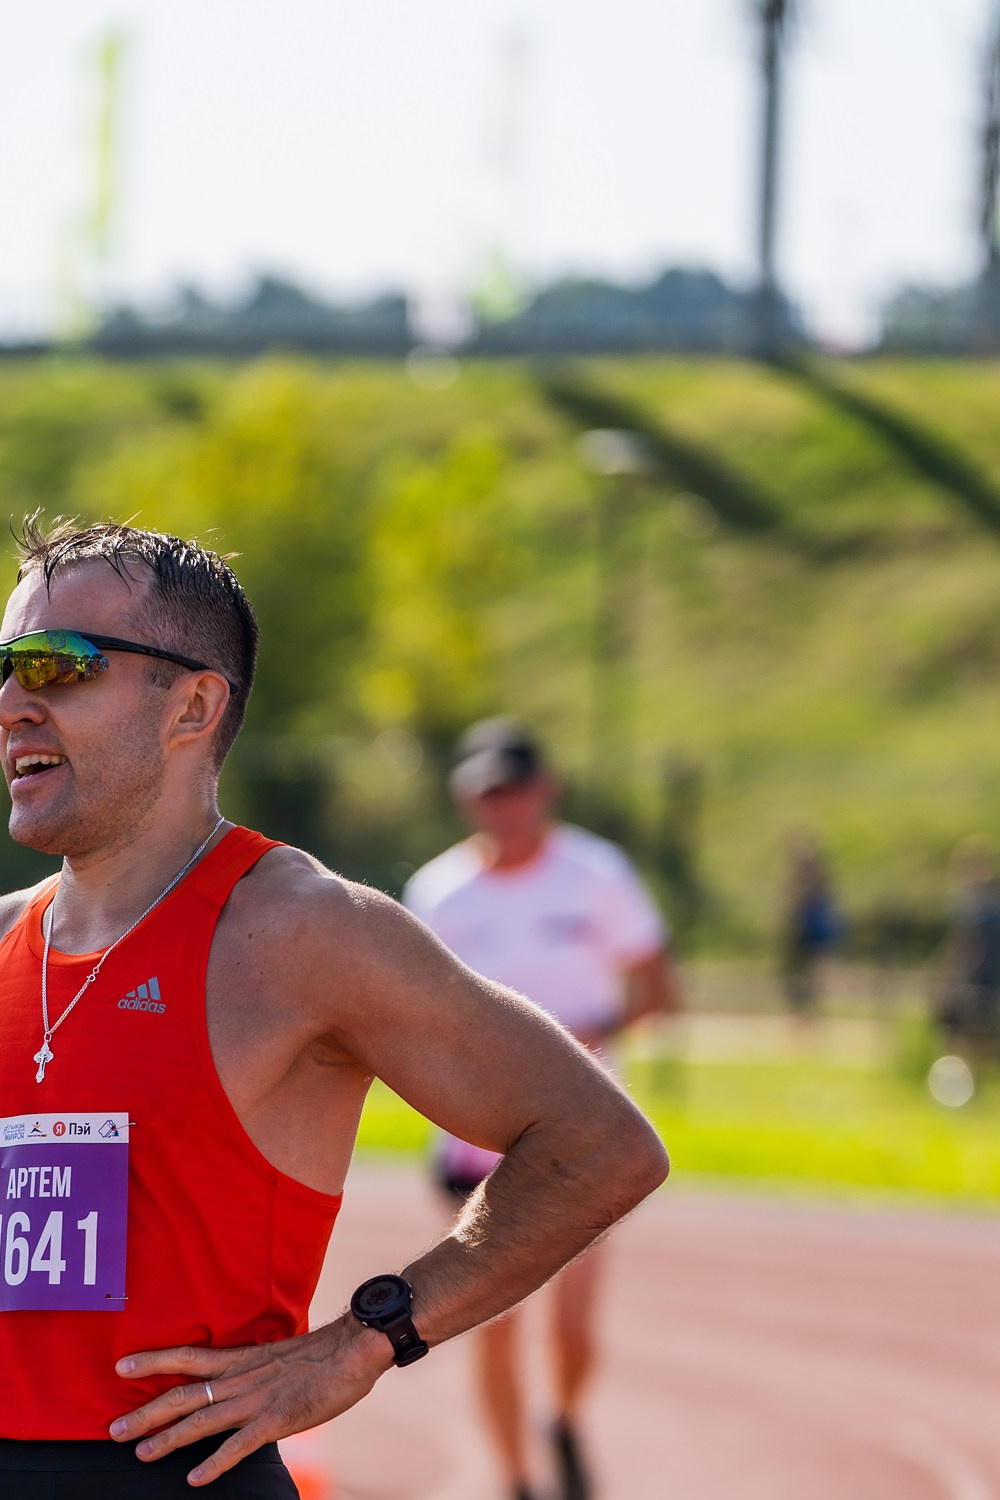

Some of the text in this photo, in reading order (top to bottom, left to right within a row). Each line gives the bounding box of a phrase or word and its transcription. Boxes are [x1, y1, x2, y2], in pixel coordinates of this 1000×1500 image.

[117, 997, 167, 1014] adidas
[69, 1122, 91, 1136] Пэй
[6, 1166, 72, 1200] АРТЕМ
